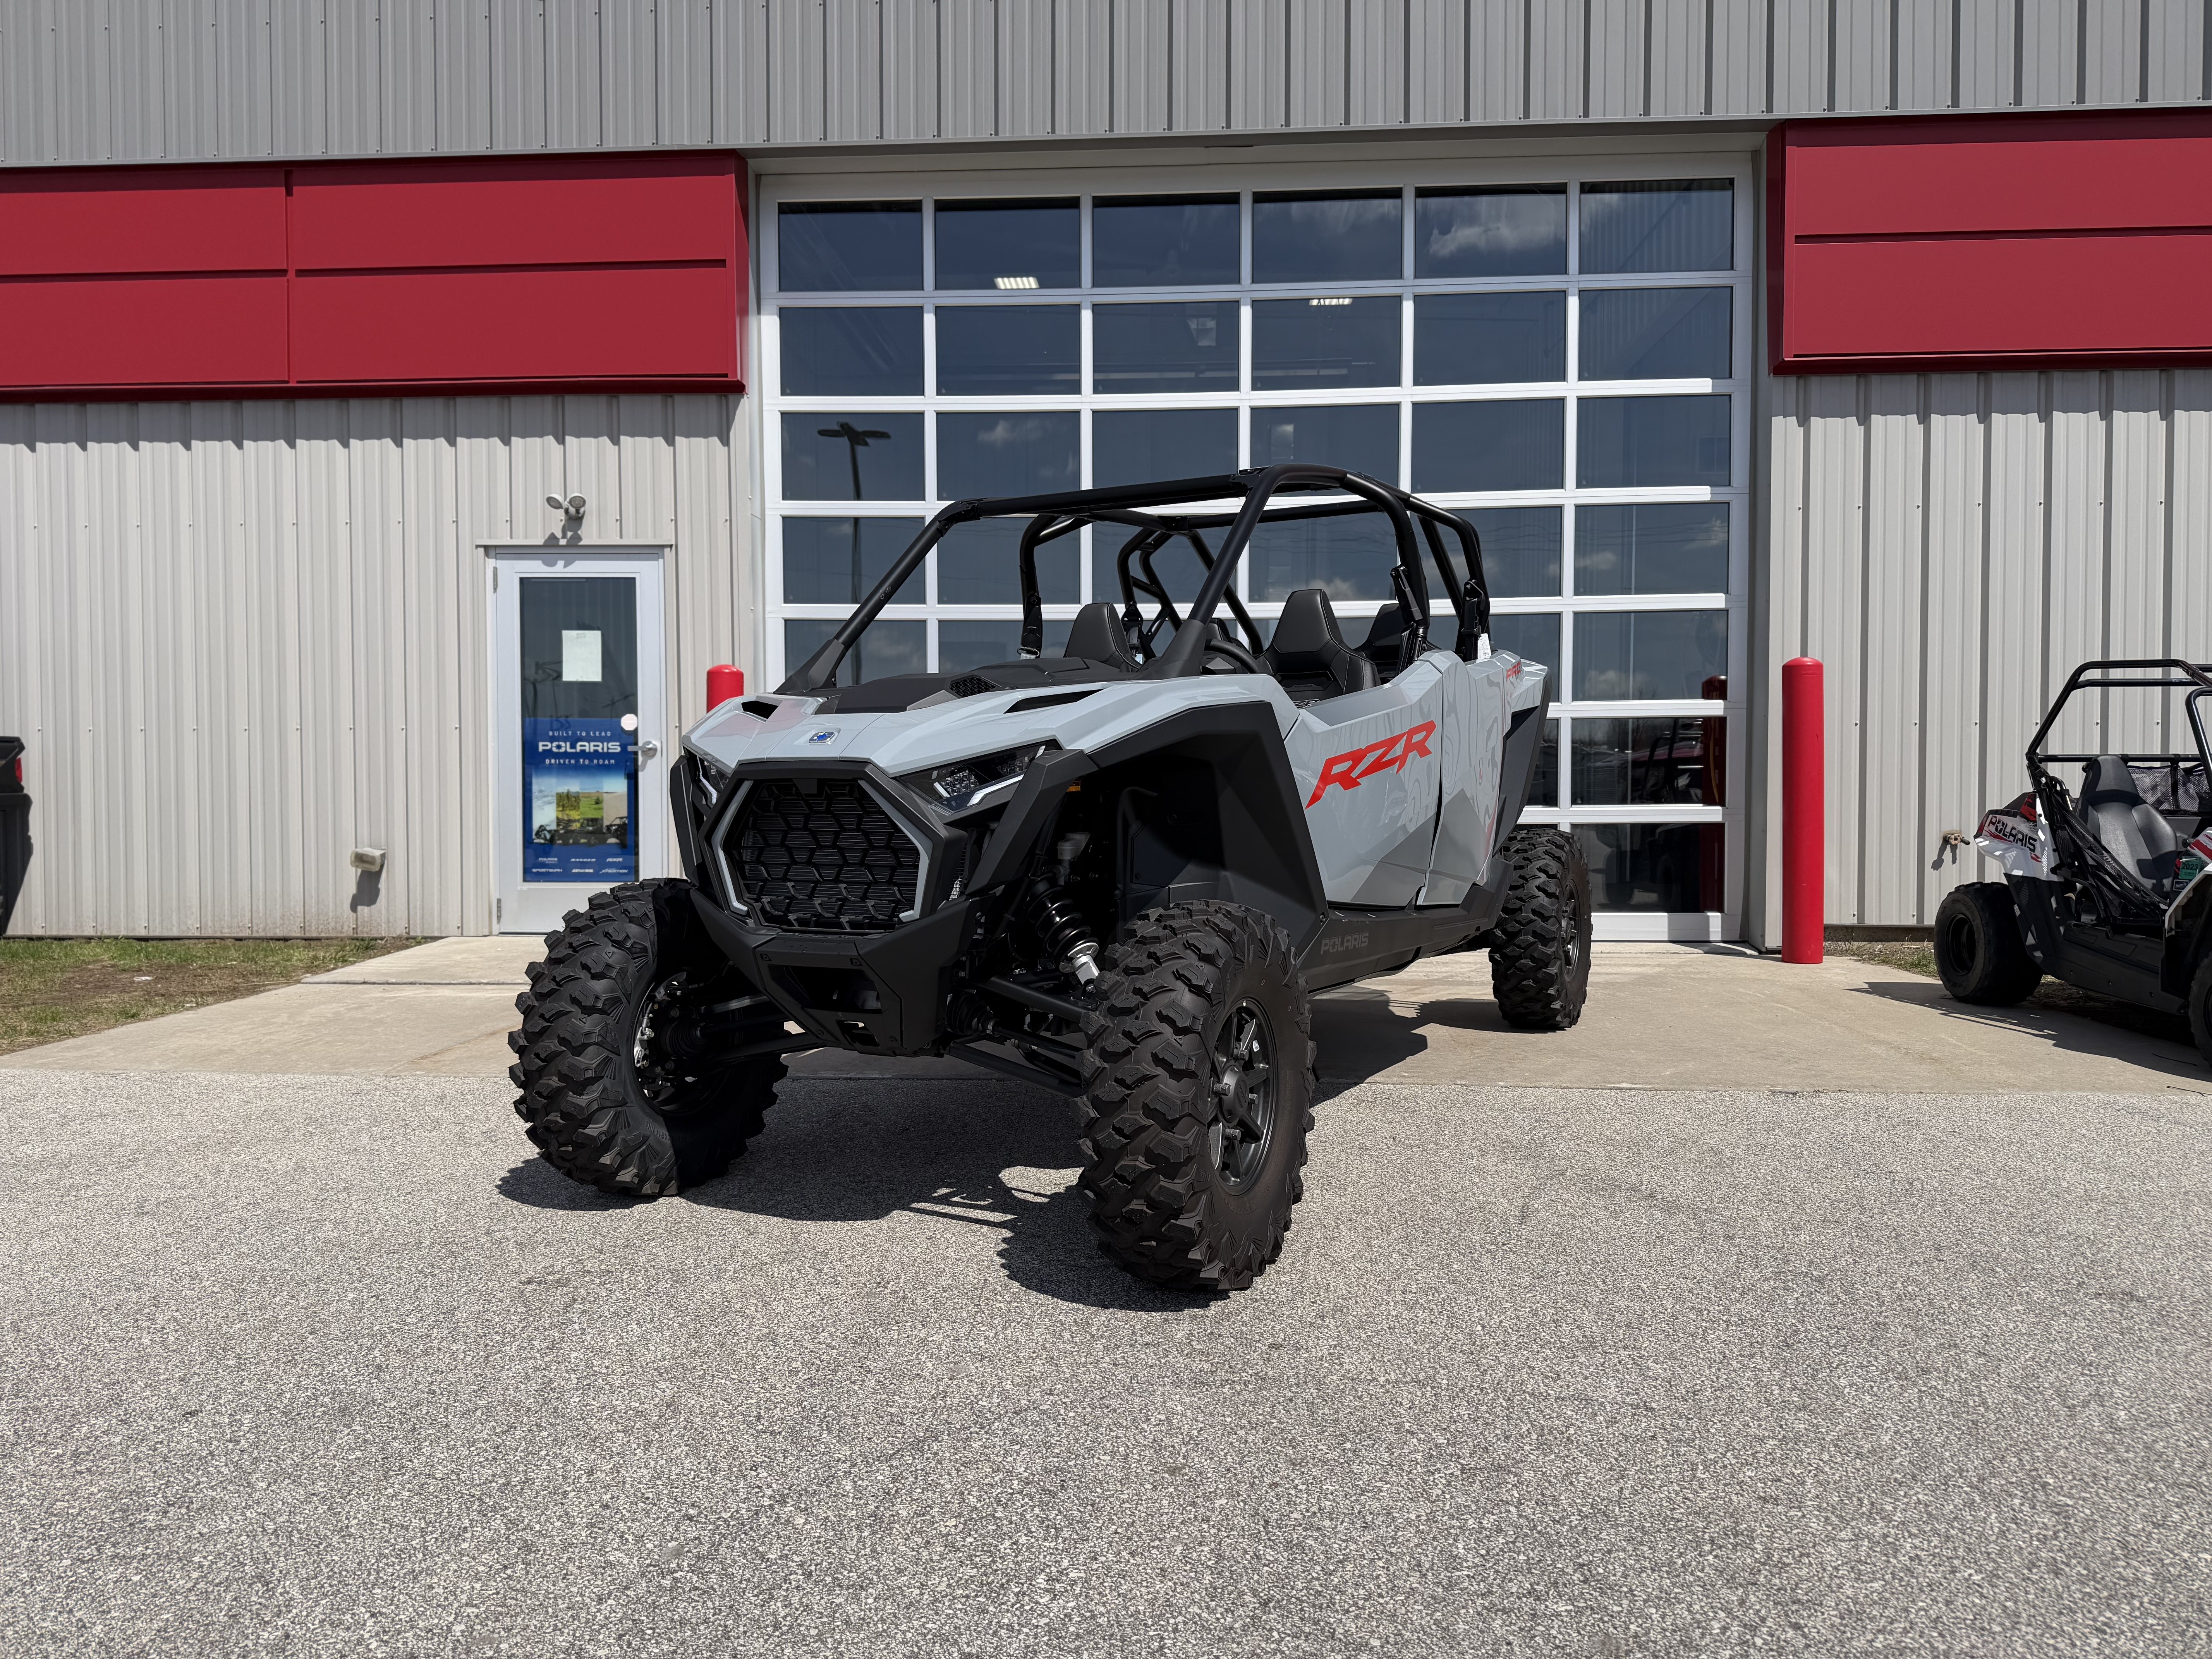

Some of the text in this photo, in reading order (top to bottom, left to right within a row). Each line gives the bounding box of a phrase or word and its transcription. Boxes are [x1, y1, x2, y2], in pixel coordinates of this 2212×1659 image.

[539, 742, 621, 752] POLARIS
[1304, 720, 1437, 810] RZR
[1988, 815, 2038, 853] POLARIS
[1320, 931, 1369, 955] POLARIS
